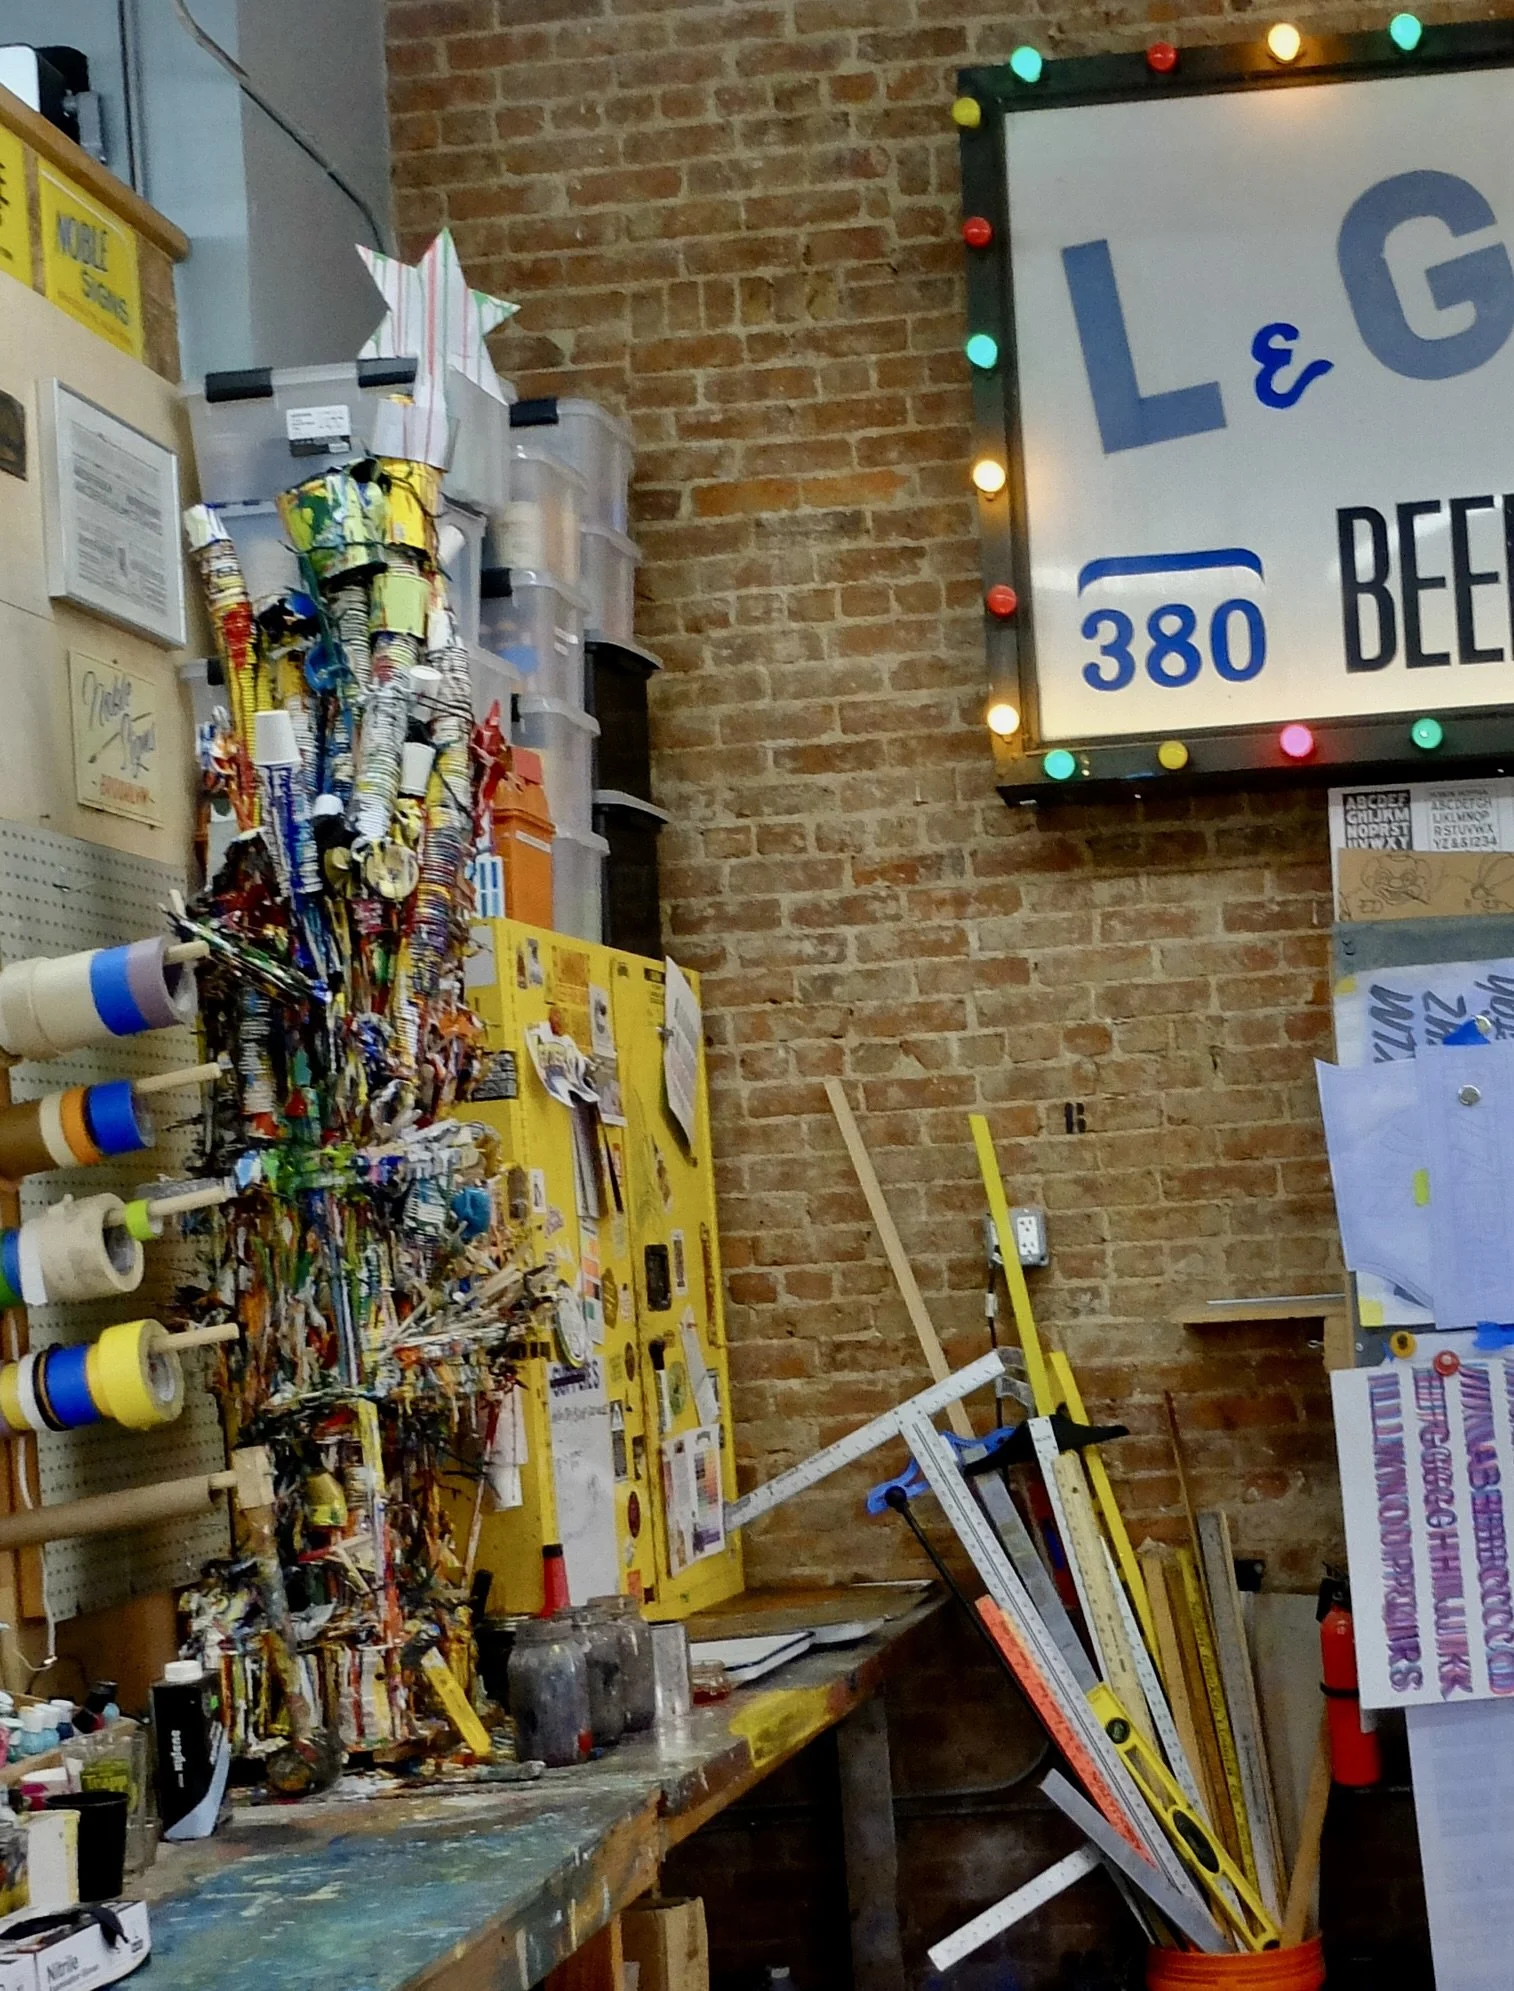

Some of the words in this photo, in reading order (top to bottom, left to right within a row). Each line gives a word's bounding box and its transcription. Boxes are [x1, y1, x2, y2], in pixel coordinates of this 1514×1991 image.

[56, 212, 109, 272] NOBLE
[1061, 239, 1228, 454] L
[1080, 597, 1268, 691] 380
[1336, 494, 1514, 674] BEE
